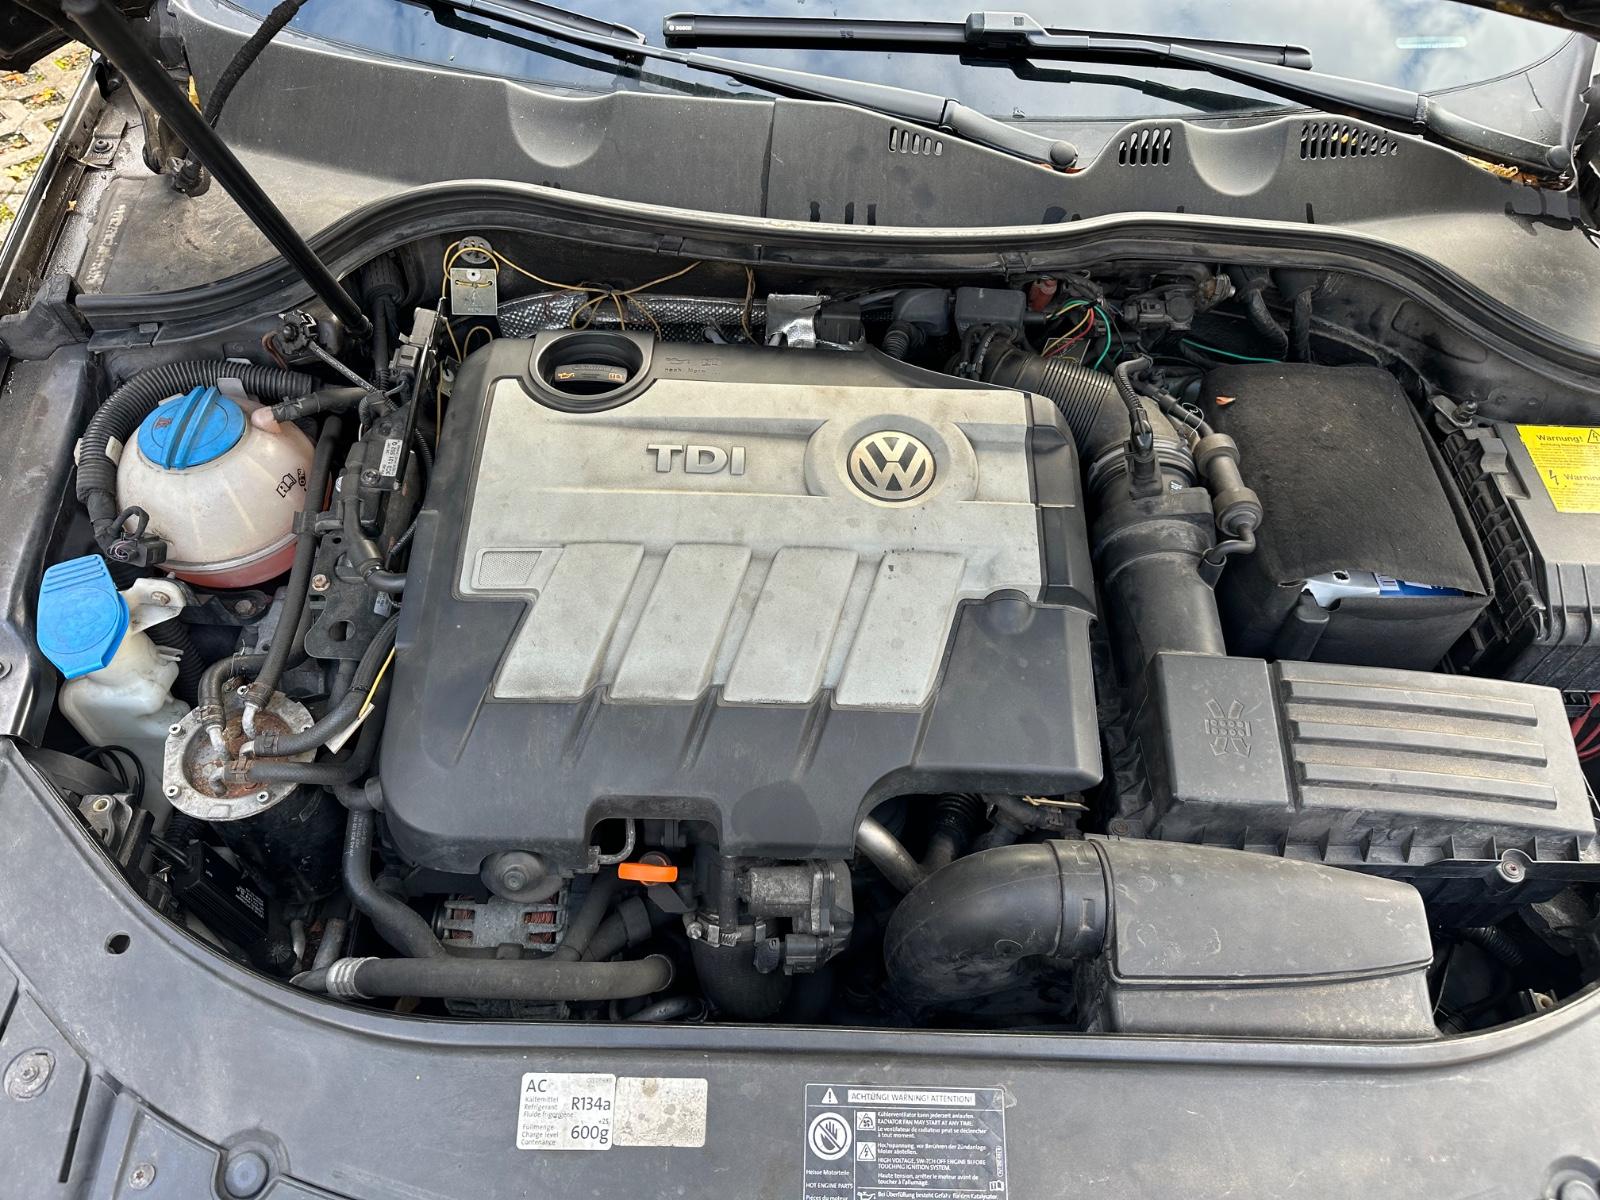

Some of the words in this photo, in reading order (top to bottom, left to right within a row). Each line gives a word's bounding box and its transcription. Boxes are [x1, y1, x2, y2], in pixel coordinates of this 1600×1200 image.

[1536, 434, 1583, 443] Warnung!
[646, 443, 747, 476] TDI
[847, 429, 937, 502] VW
[526, 1079, 547, 1093] AC
[571, 1096, 611, 1111] R134a
[891, 1093, 929, 1102] WARNING!
[931, 1094, 973, 1103] ATTENTION!
[523, 1103, 558, 1112] Refrigerant
[522, 1123, 554, 1131] Füllmenge
[521, 1131, 543, 1139] Charge
[571, 1125, 609, 1144] 600g
